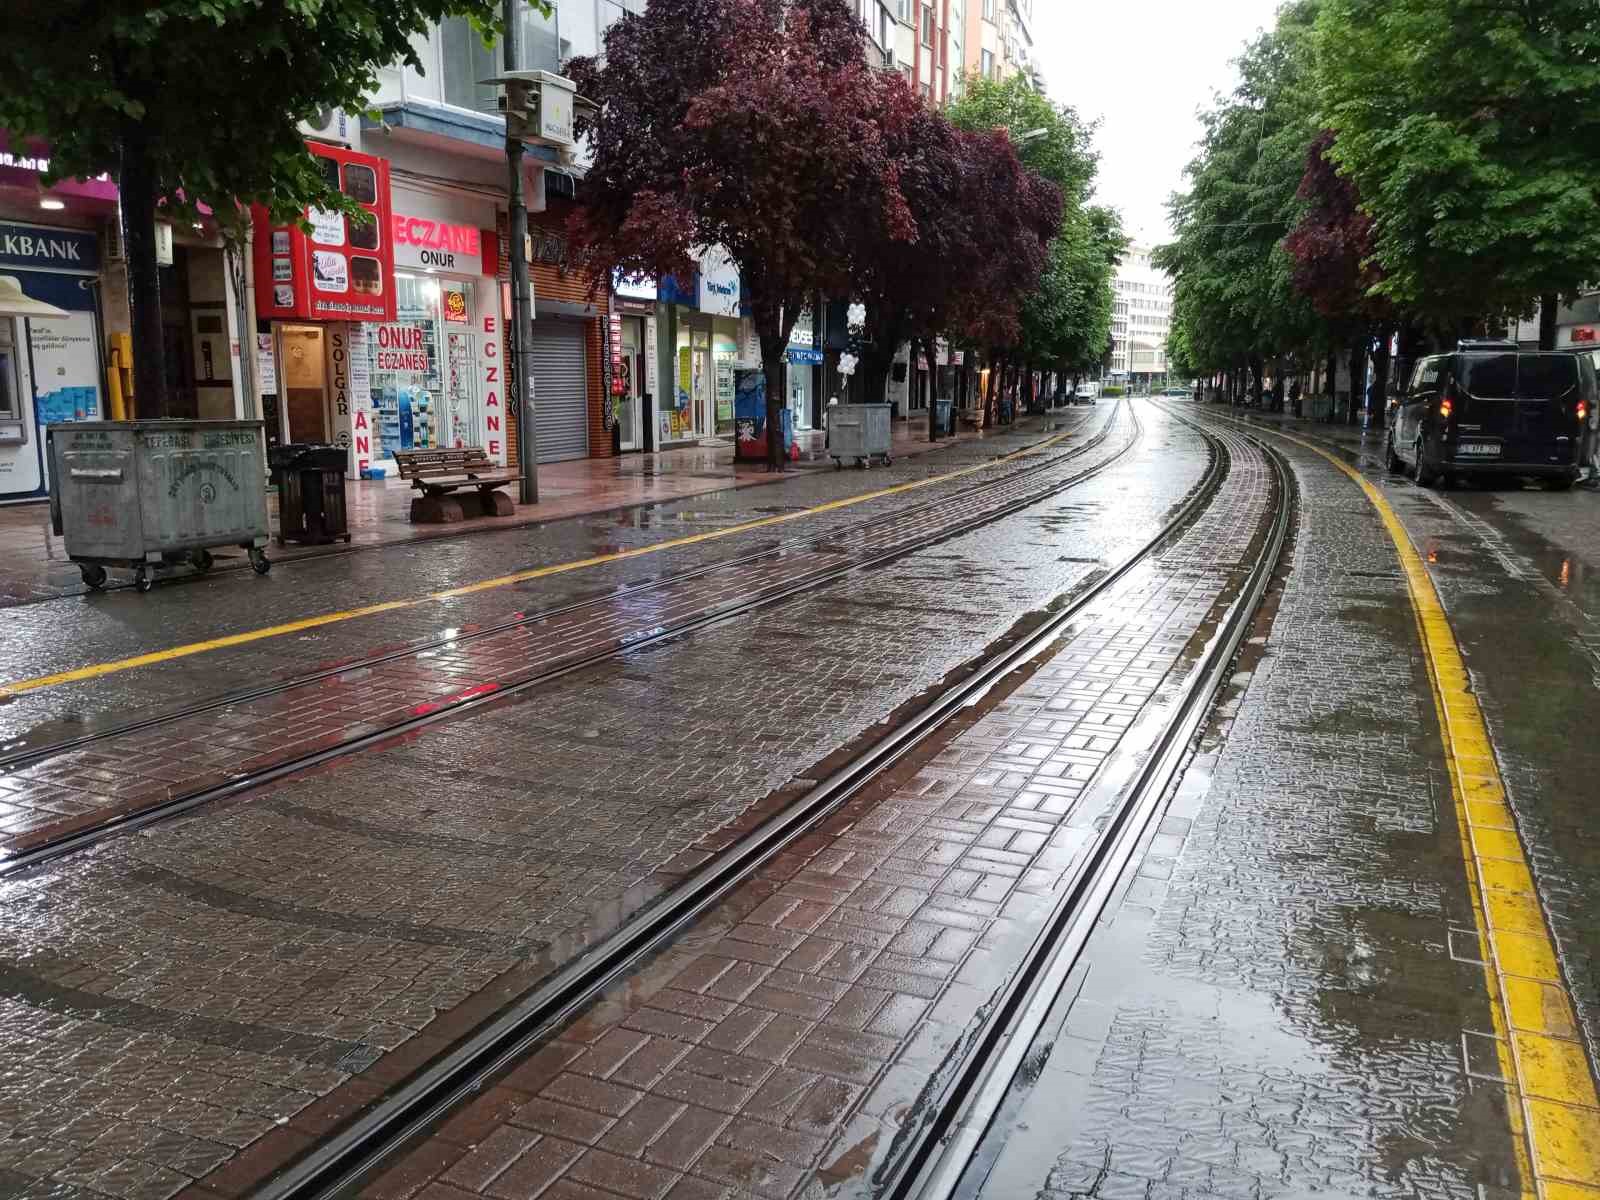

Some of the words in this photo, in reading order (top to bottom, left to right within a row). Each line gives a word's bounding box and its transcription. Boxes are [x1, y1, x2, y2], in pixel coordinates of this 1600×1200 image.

[392, 214, 480, 257] ECZANE
[421, 250, 455, 268] ONUR
[378, 326, 424, 350] ONUR
[332, 334, 348, 416] SOLGAR
[484, 317, 500, 455] ECZANE
